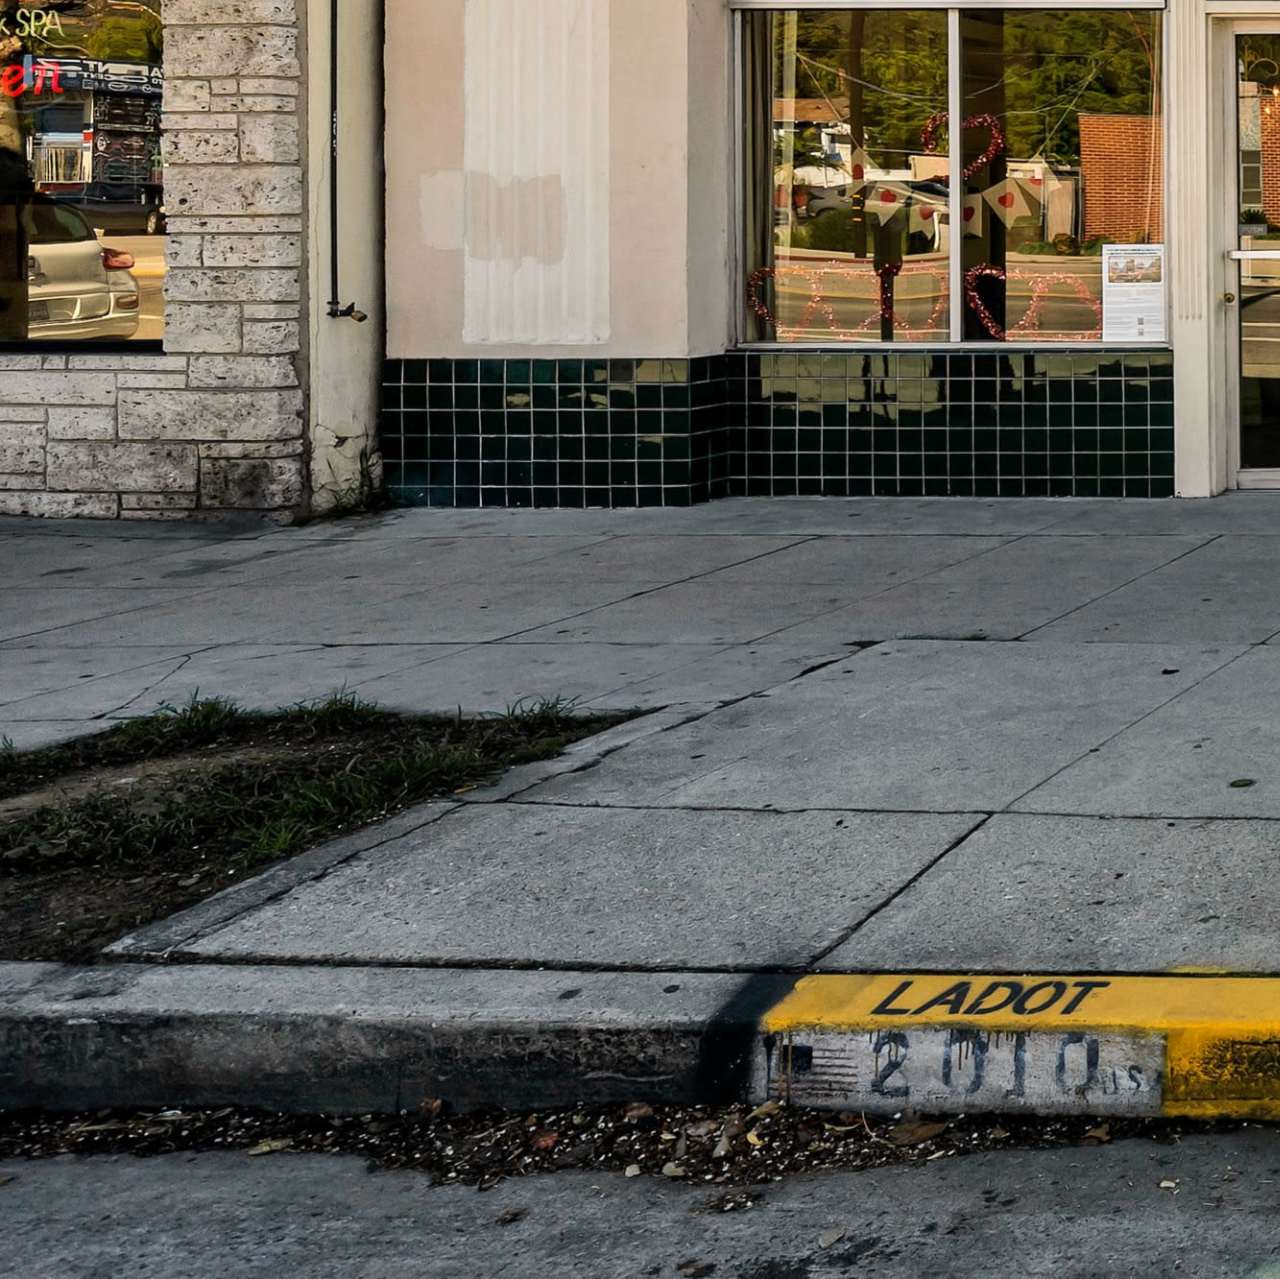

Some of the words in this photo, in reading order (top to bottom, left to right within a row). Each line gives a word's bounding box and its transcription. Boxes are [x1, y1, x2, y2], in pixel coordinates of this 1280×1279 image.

[16, 9, 65, 37] SPA
[870, 979, 1110, 1016] LADOT
[871, 1027, 1099, 1098] 2010
